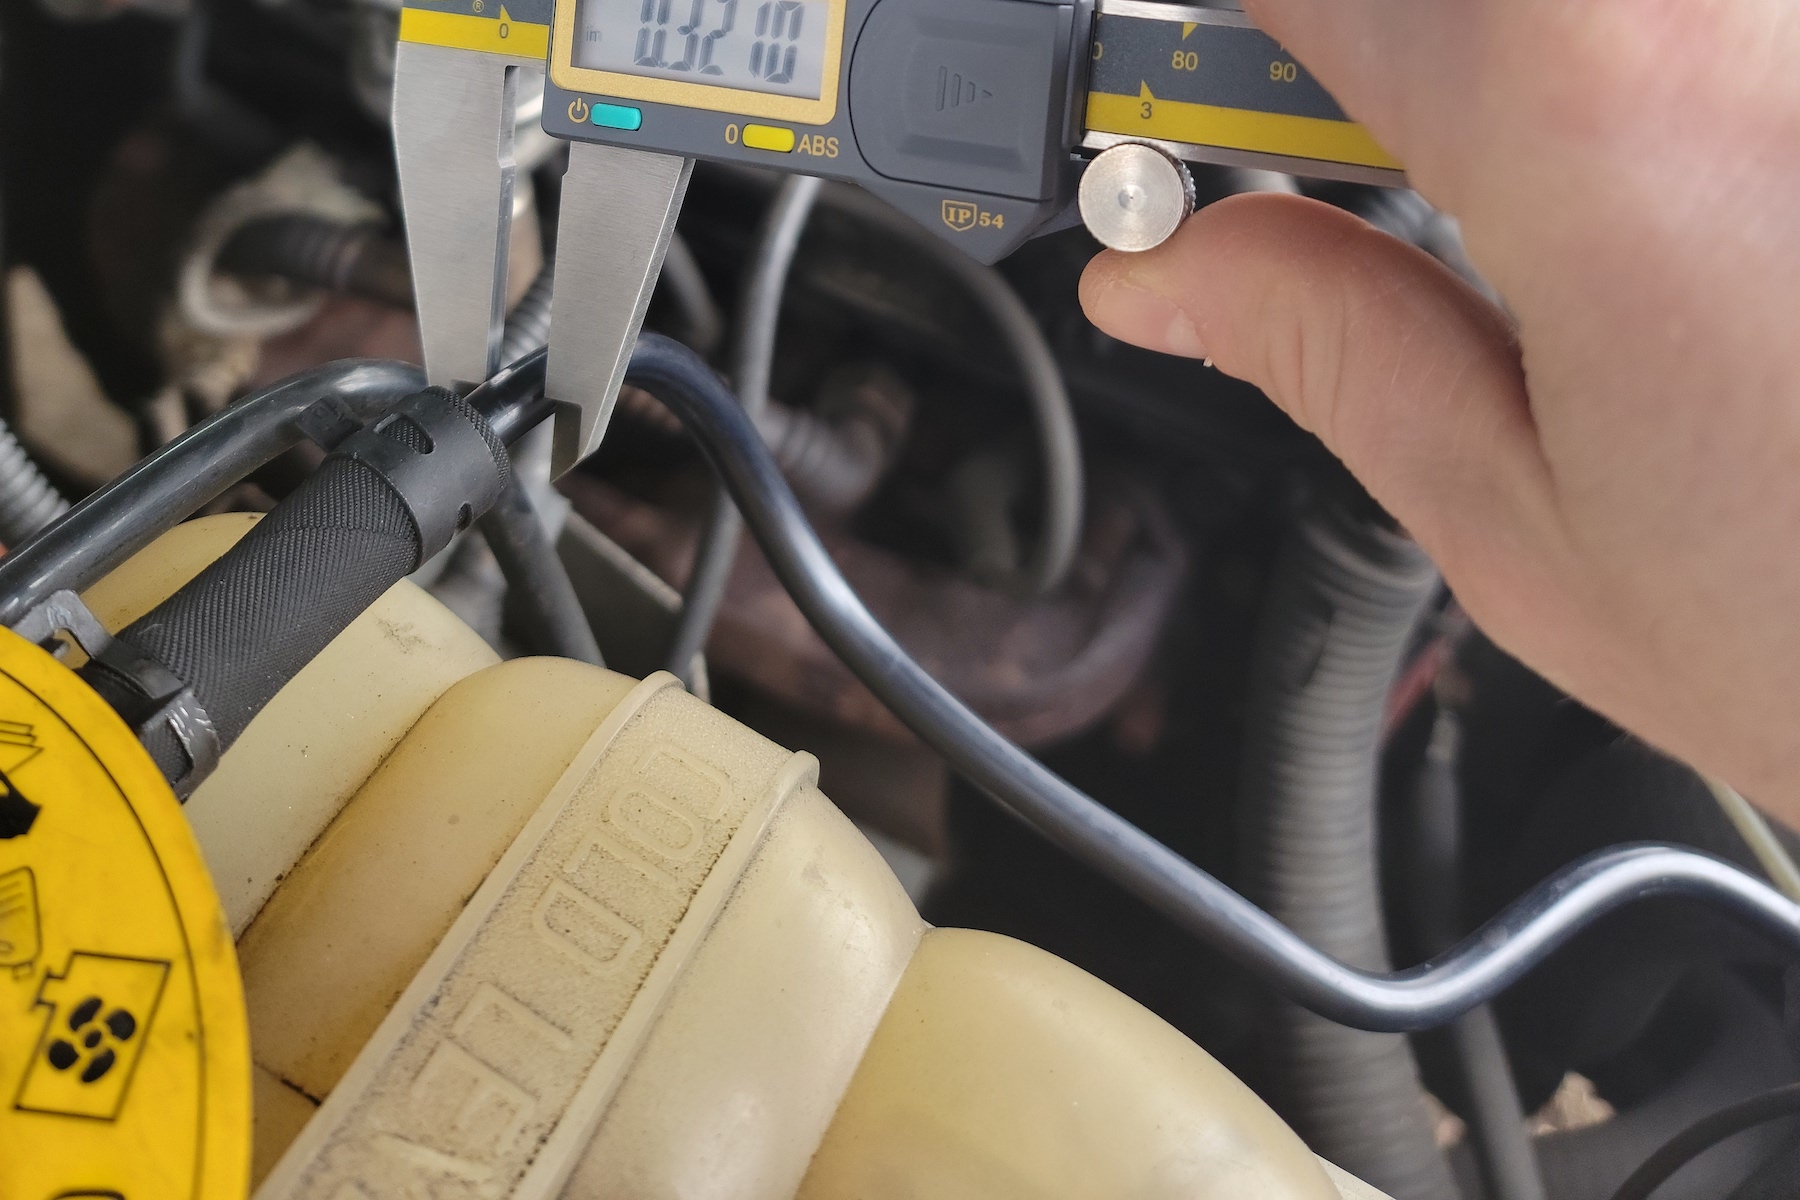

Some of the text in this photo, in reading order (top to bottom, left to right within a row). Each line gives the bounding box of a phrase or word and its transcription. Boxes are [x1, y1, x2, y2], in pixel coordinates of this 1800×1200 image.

[499, 23, 509, 39] 0
[1171, 50, 1199, 71] 80
[1269, 61, 1297, 82] 90
[1140, 101, 1153, 120] 3
[797, 133, 840, 158] ABS
[947, 206, 1004, 229] IP 54
